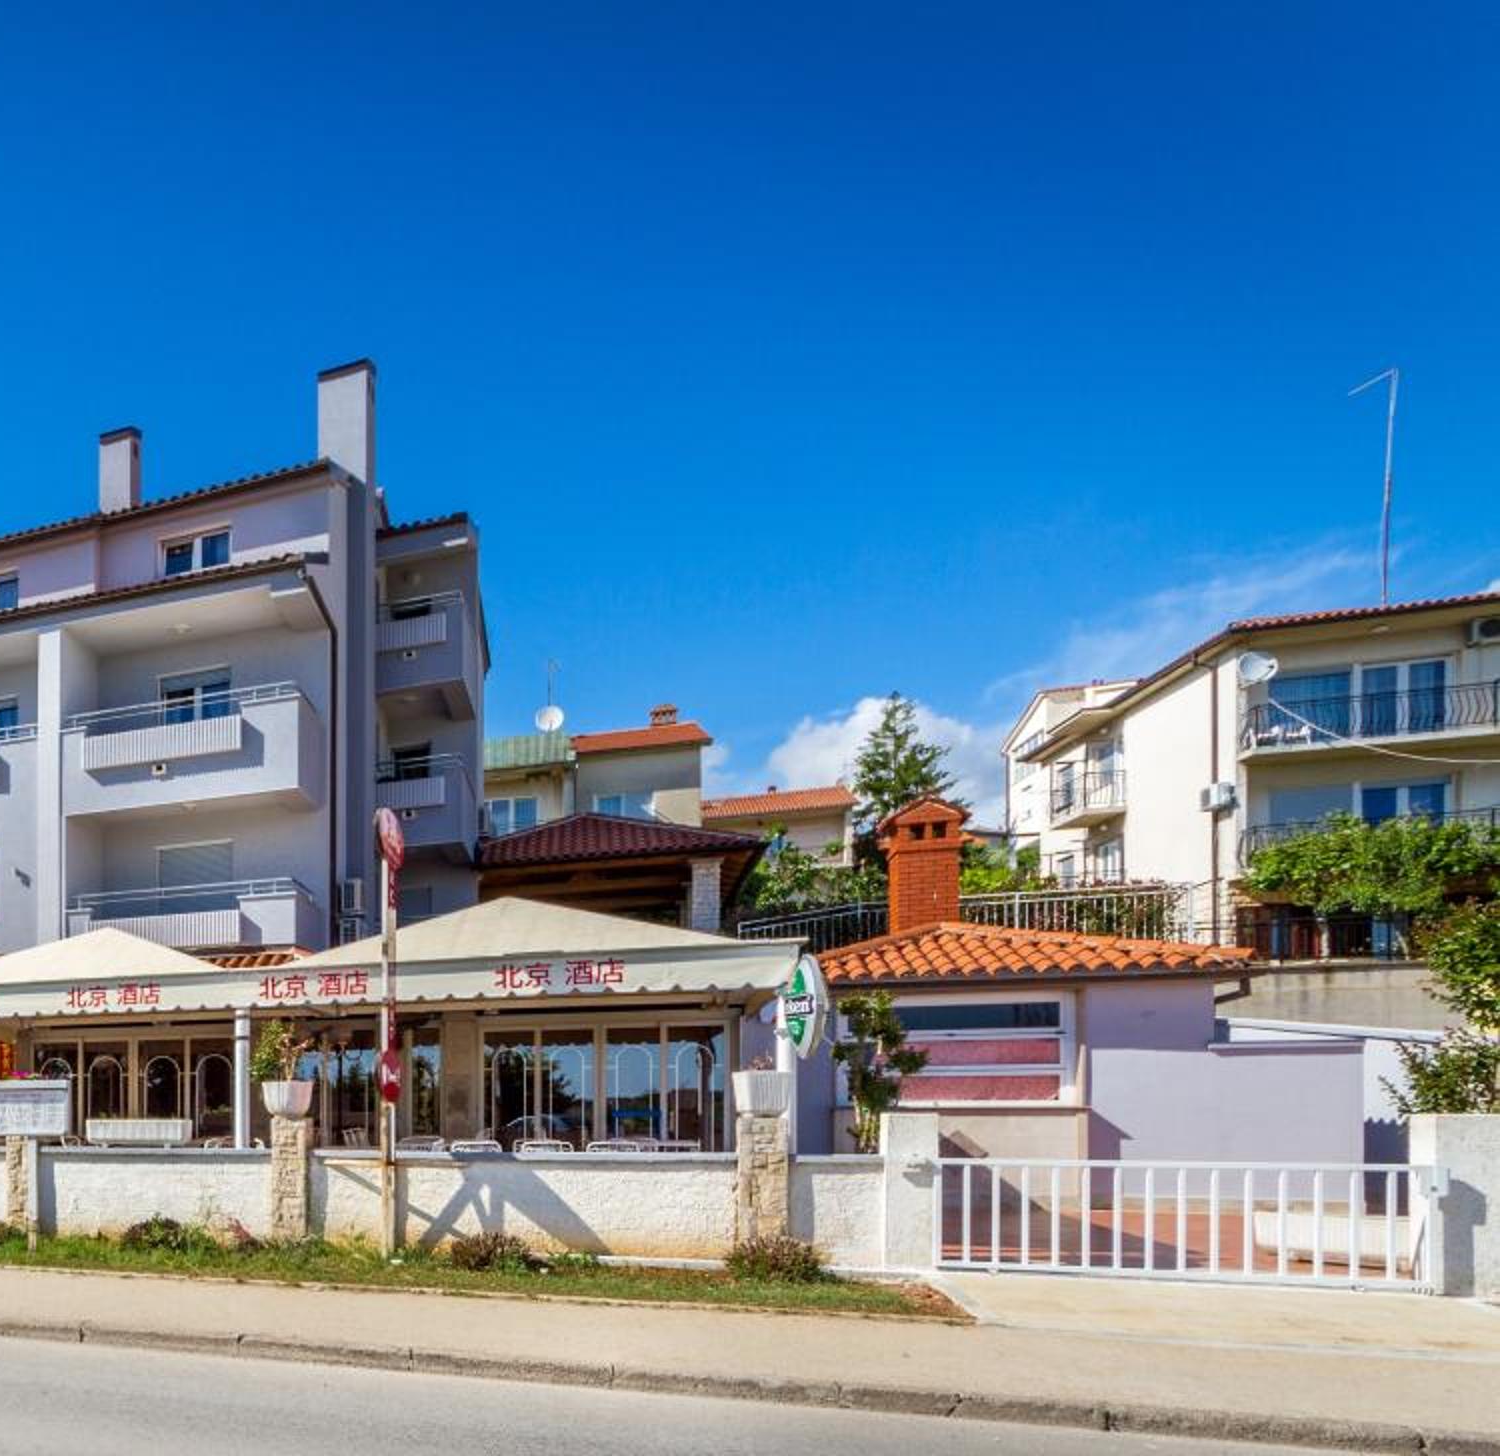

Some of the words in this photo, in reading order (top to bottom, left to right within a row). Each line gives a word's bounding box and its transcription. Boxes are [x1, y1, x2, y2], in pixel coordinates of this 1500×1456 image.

[259, 976, 308, 999] 北京
[317, 971, 368, 996] 酒店
[494, 963, 552, 989] 北京
[565, 959, 624, 985] 酒店
[68, 987, 108, 1008] 北京
[117, 984, 160, 1005] 酒店
